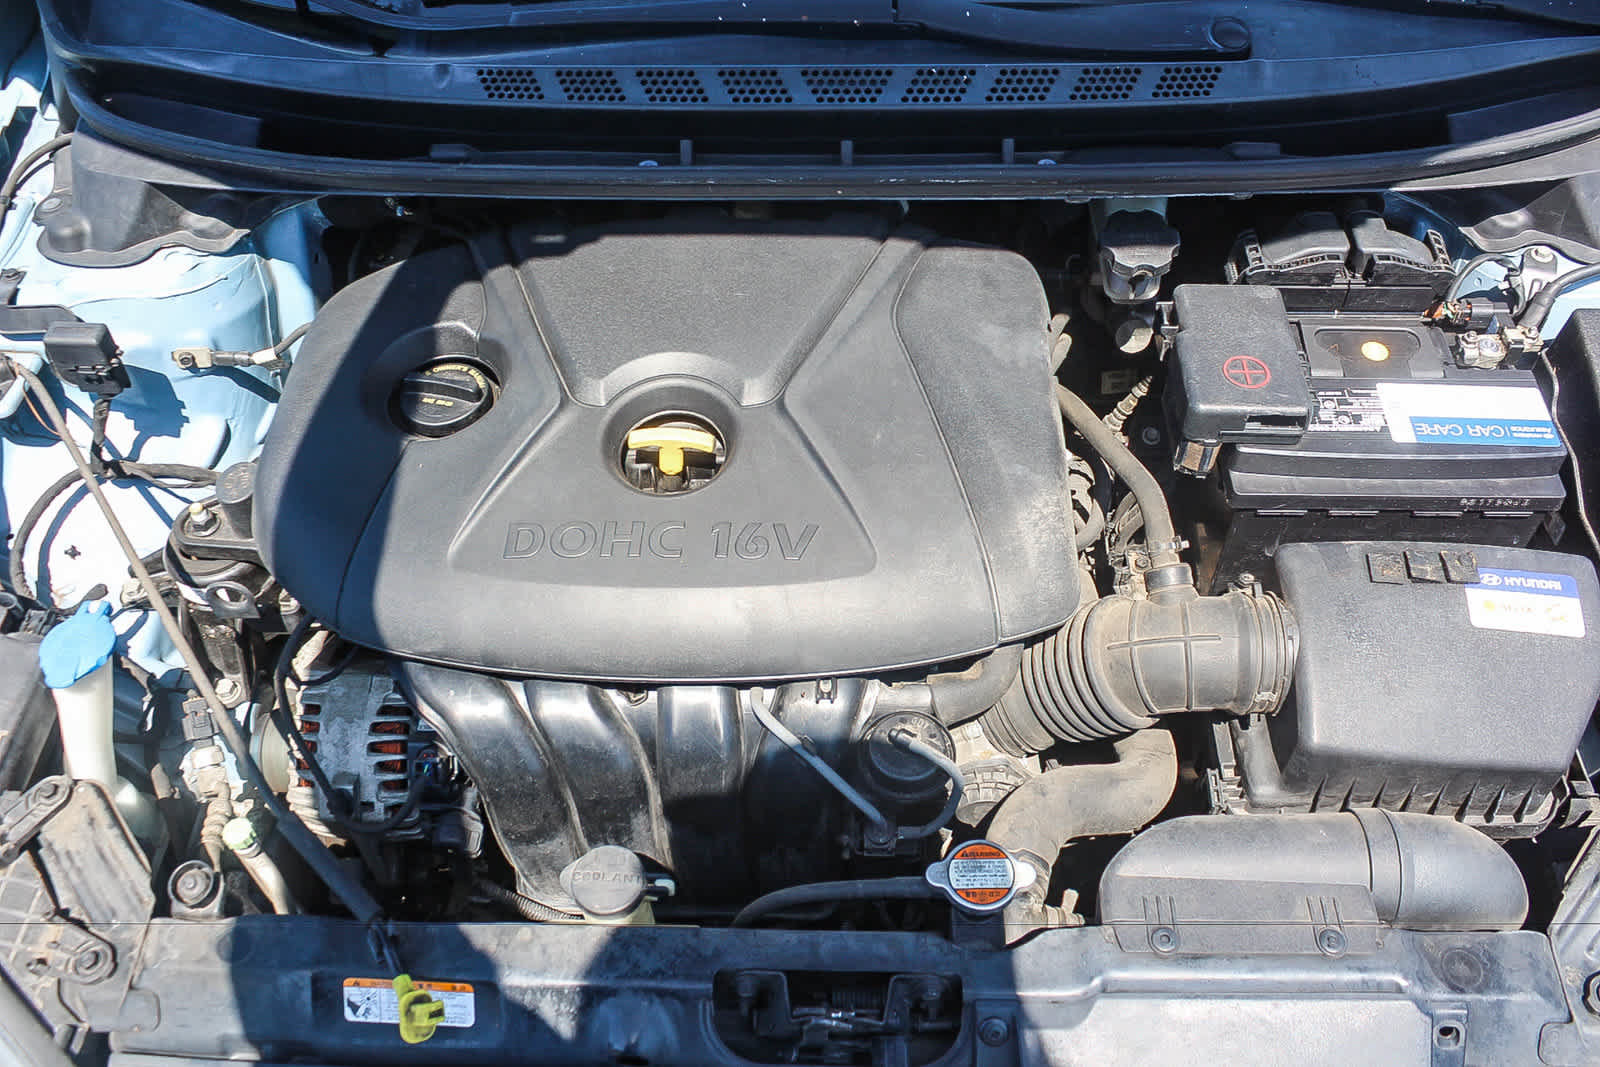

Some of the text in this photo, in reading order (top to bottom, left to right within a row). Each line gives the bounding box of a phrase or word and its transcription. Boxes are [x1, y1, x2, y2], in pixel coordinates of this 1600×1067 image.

[1415, 423, 1463, 437] CARE
[1466, 423, 1505, 438] CAR
[503, 520, 820, 561] DOHC 16V
[1503, 576, 1562, 591] HYUNDAI
[574, 871, 641, 884] COOLANT
